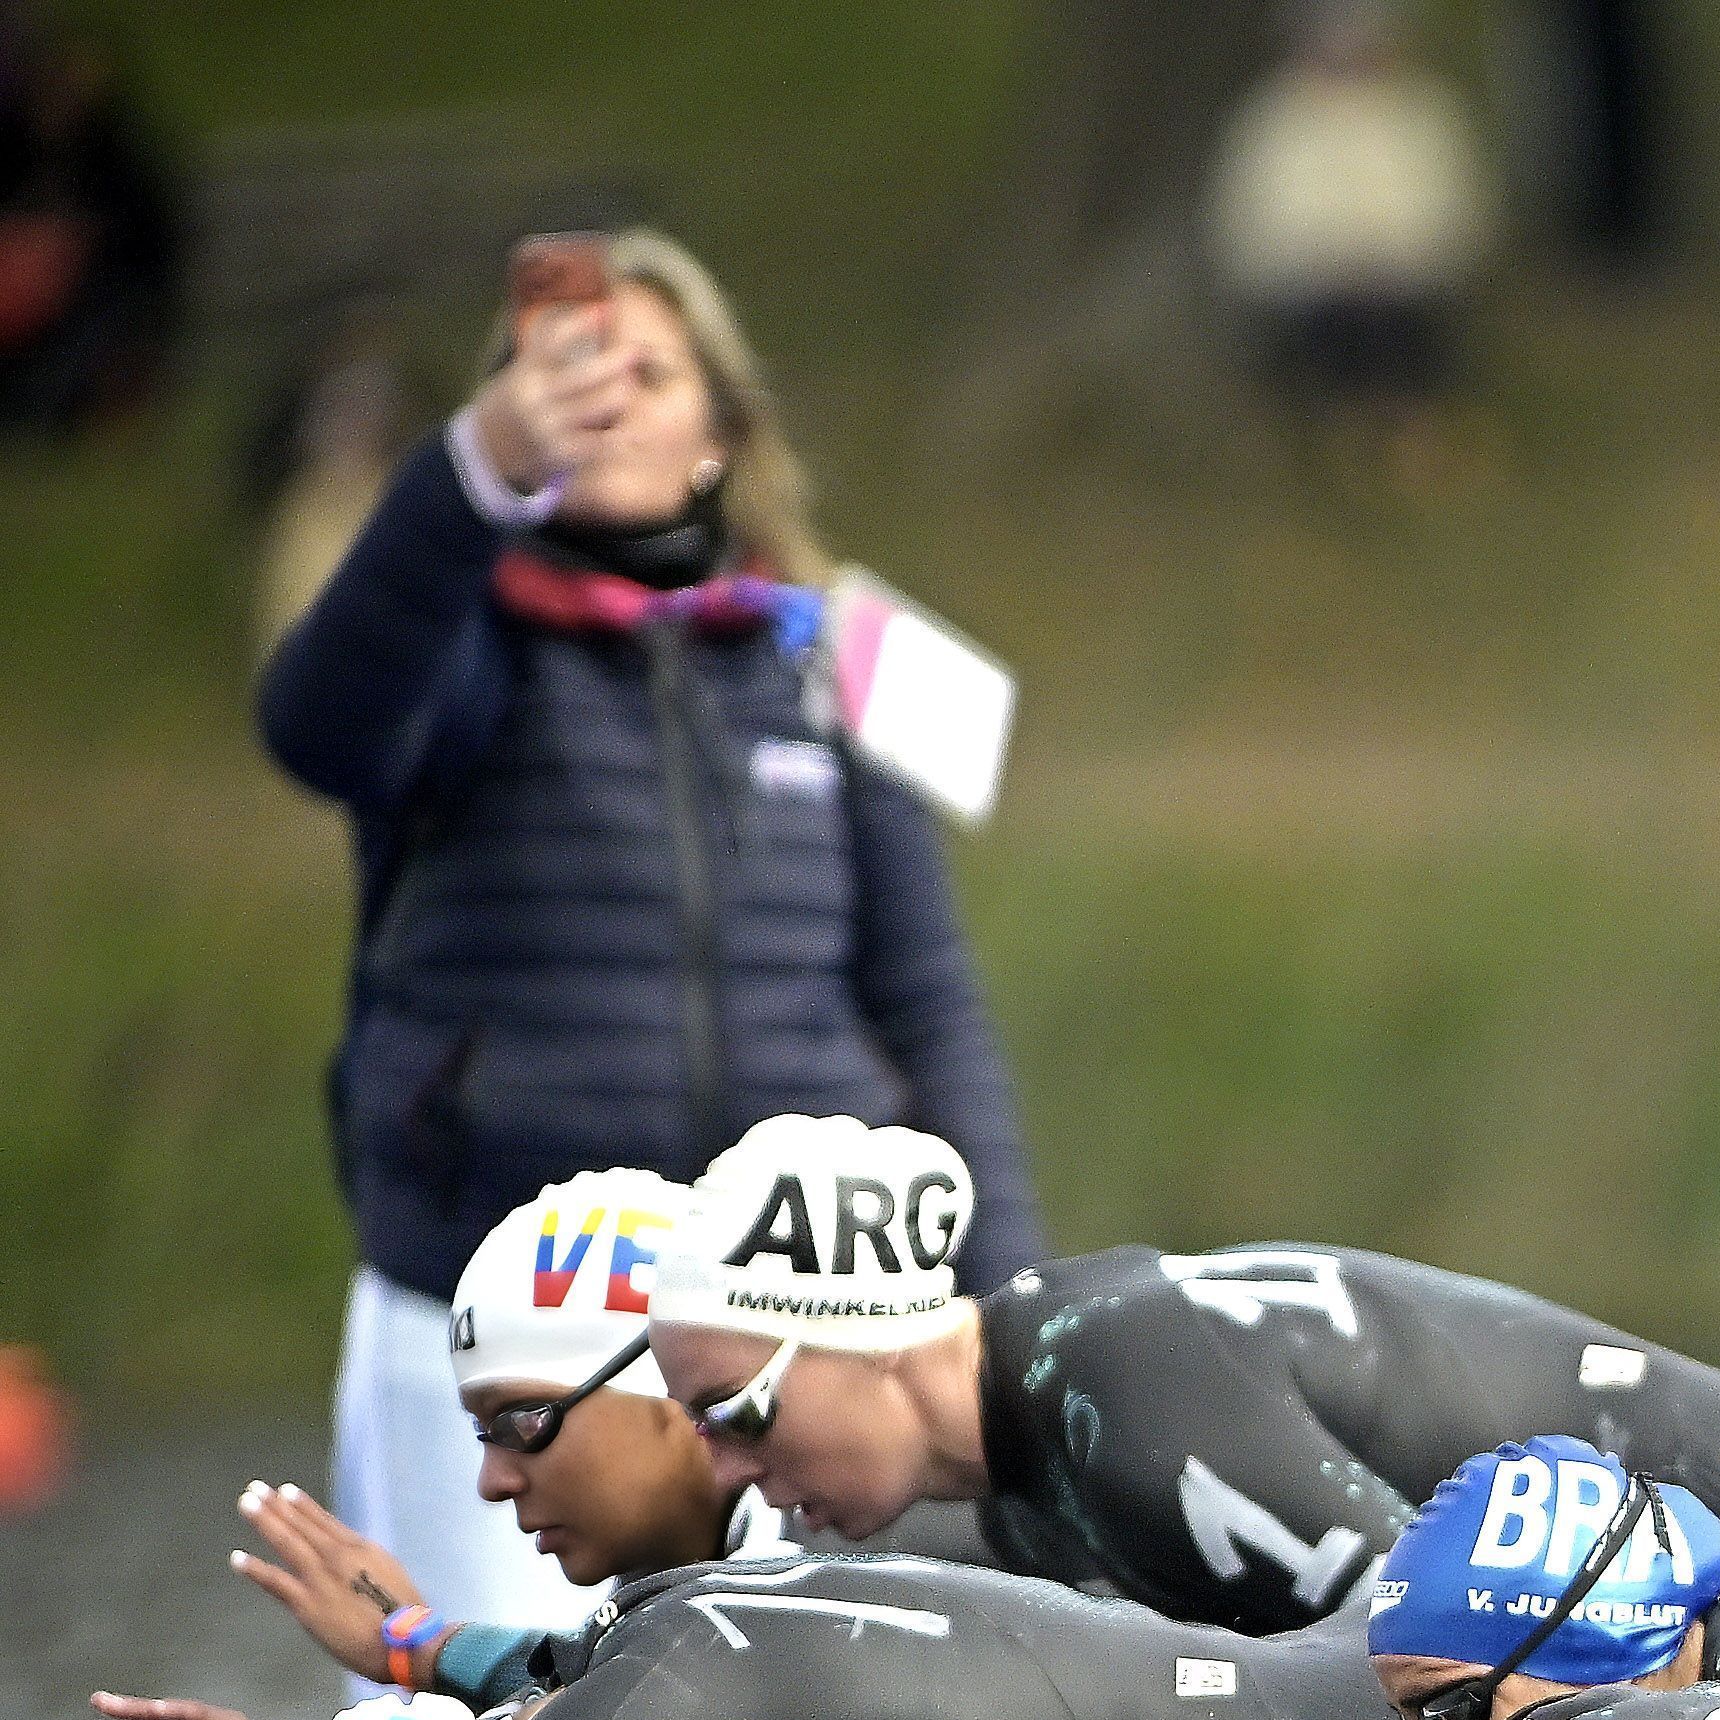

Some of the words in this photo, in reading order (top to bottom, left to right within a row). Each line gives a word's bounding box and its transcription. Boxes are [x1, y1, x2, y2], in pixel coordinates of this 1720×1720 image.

[719, 1171, 957, 1275] ARG
[1468, 1454, 1697, 1586] BRA
[1467, 1587, 1496, 1613] V.
